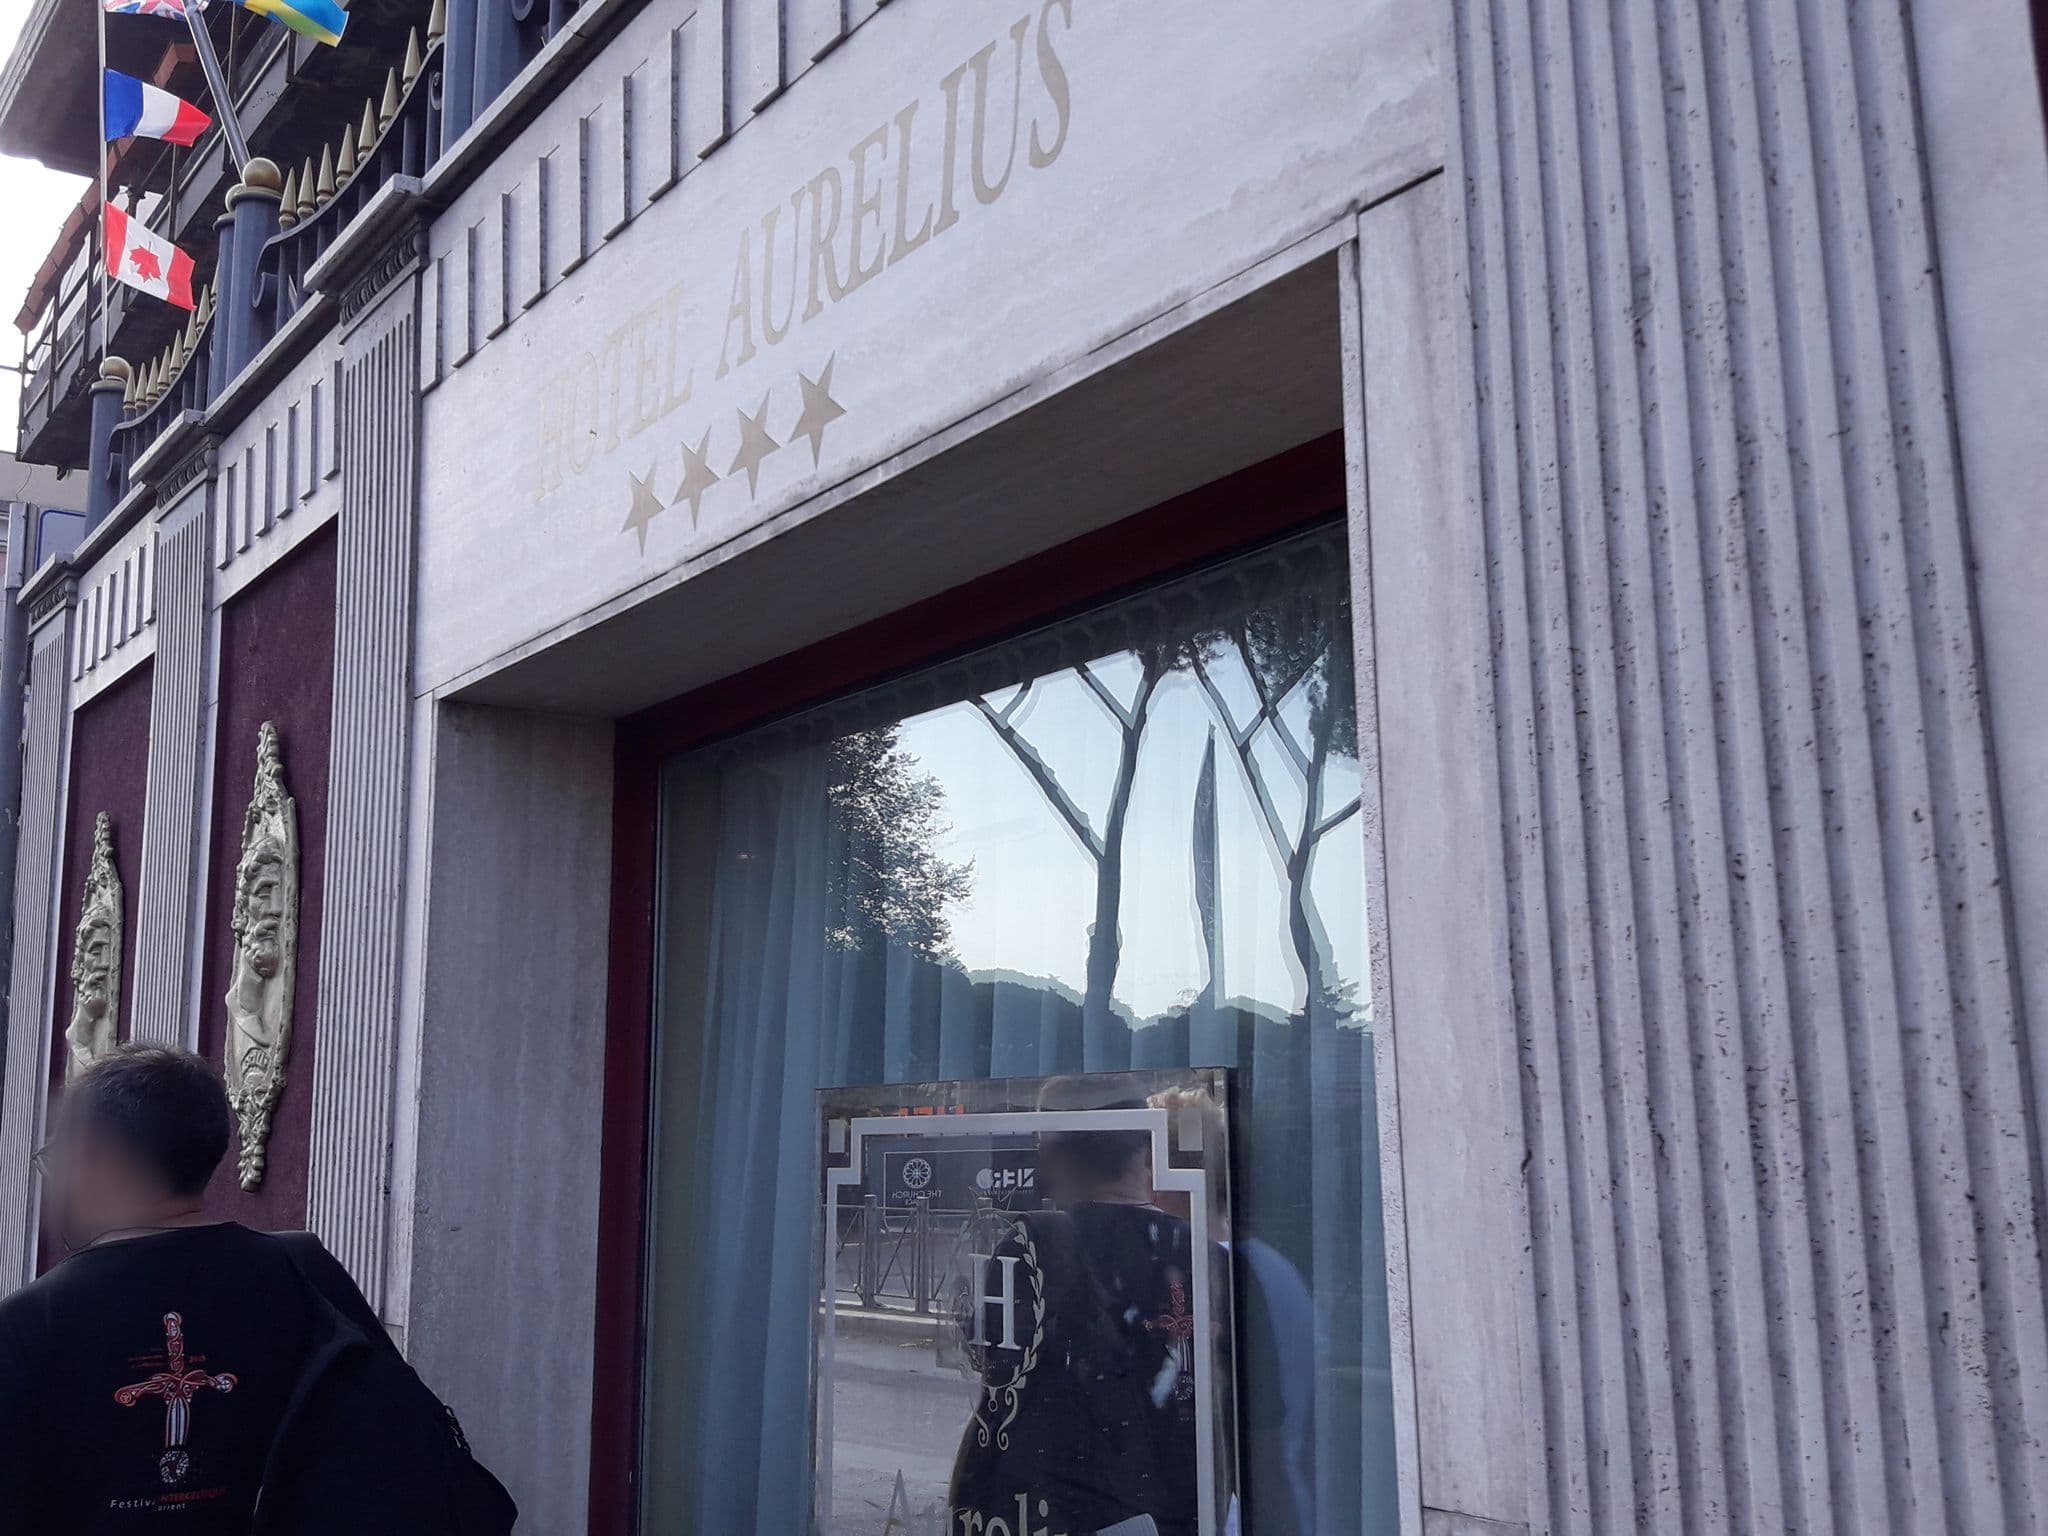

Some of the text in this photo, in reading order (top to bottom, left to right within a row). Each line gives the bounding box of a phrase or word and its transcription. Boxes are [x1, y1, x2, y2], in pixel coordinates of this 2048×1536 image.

[535, 0, 1072, 502] HOTEL AURELIUS
[968, 1253, 1021, 1350] H
